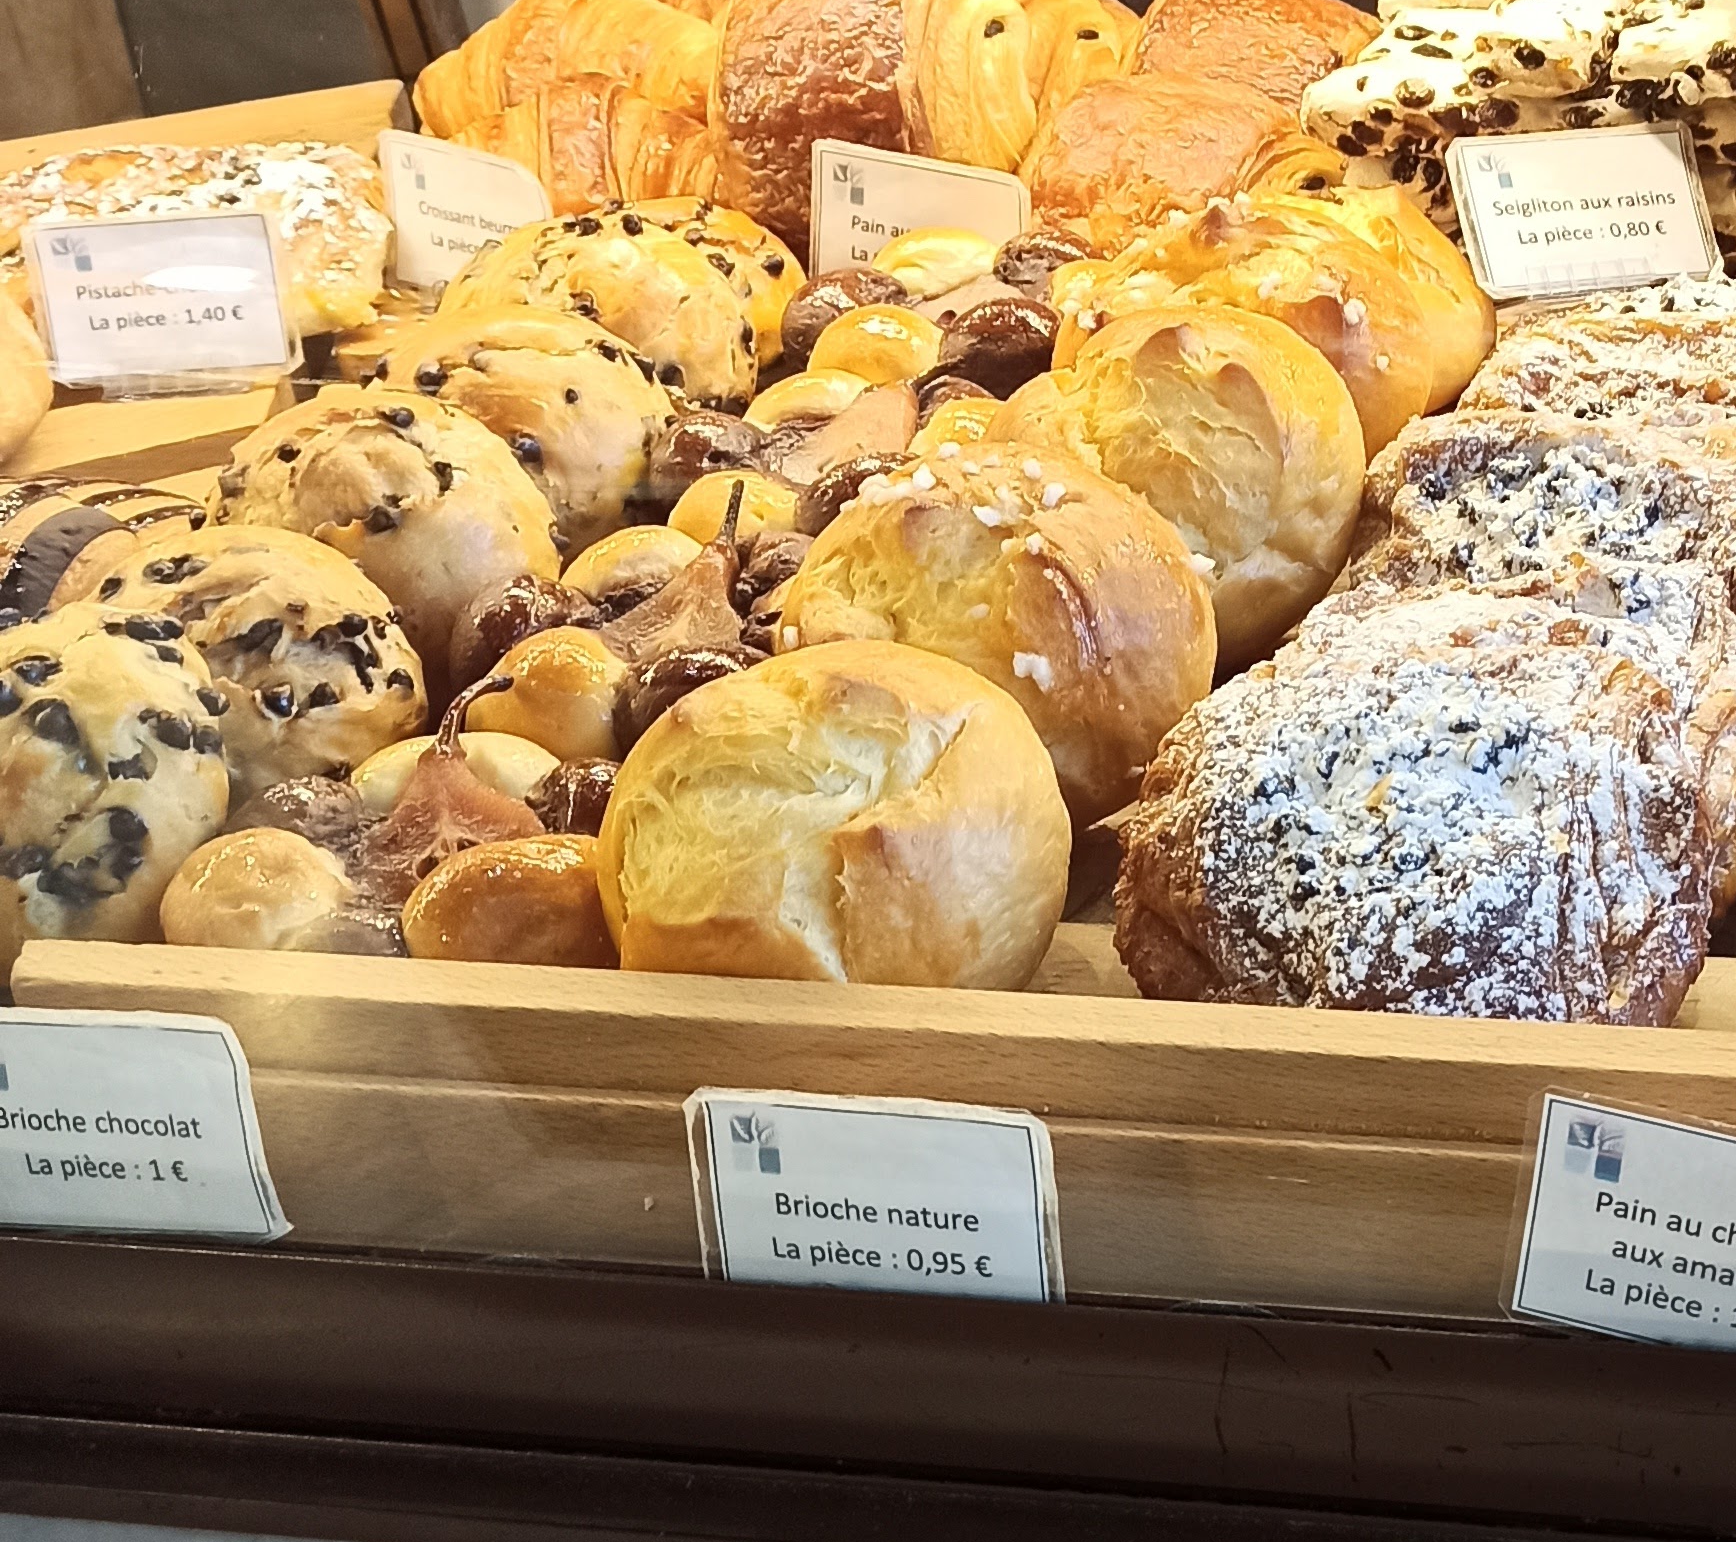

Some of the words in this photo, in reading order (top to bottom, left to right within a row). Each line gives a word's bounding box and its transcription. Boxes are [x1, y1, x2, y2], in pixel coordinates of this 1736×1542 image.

[418, 201, 475, 227] Croissant
[1492, 197, 1574, 218] Seigliton
[1580, 196, 1612, 210] aux
[1617, 189, 1676, 208] raisins
[430, 231, 444, 247] La
[851, 215, 885, 235] Pain
[1517, 229, 1538, 245] La
[1545, 225, 1593, 246] pièce
[1610, 221, 1650, 240] 0,80
[1655, 220, 1667, 235] €
[851, 244, 868, 262] La
[89, 315, 110, 331] La
[116, 311, 166, 332] pièce
[184, 306, 226, 326] 1,40
[231, 305, 244, 321] €
[95, 1110, 202, 1139] chocolat
[25, 1153, 53, 1176] La
[61, 1154, 126, 1182] pièce
[149, 1158, 165, 1182] 1
[171, 1160, 188, 1183] €
[775, 1192, 878, 1223] Brioche
[887, 1206, 980, 1232] nature
[1595, 1191, 1657, 1226] Pain
[1666, 1214, 1702, 1238] au
[772, 1236, 801, 1260] La
[810, 1241, 882, 1268] pièce
[906, 1248, 966, 1277] 0,95
[974, 1255, 994, 1277] €
[1611, 1240, 1664, 1268] aux
[1585, 1268, 1616, 1297] La
[1624, 1282, 1703, 1318] pièce
